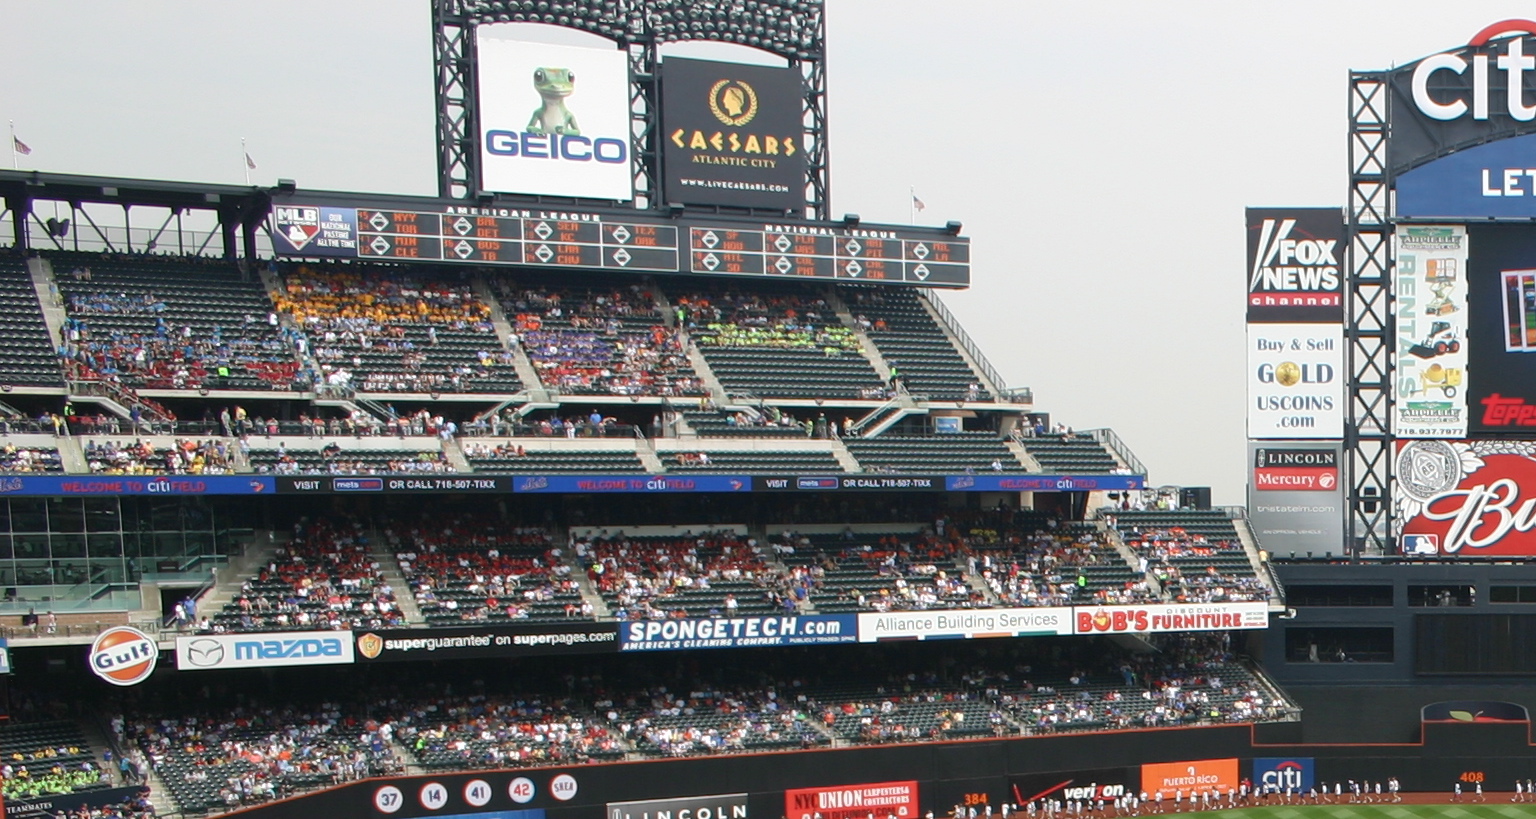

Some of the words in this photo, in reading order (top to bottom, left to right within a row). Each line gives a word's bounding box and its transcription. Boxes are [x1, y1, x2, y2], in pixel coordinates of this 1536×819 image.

[486, 130, 627, 165] GEICO
[671, 129, 797, 157] CAESARS
[692, 155, 748, 168] ATLANTIC
[750, 159, 777, 169] CITY
[277, 209, 317, 222] MLB
[447, 206, 530, 218] AMERICAN
[540, 212, 601, 222] LEAGUE
[765, 225, 835, 236] NATIONAL
[844, 229, 897, 240] LEAGUE
[395, 248, 418, 257] CLE
[1279, 240, 1338, 265] FOX
[1262, 267, 1339, 291] NEWS
[1251, 296, 1339, 306] channel
[1398, 255, 1416, 399] RENTALS
[1256, 339, 1285, 353] Buy
[1290, 340, 1302, 351] &
[1305, 338, 1334, 351] Sell
[1257, 362, 1334, 387] GOLD
[1256, 395, 1334, 411] USCOINS
[1276, 413, 1314, 429] .com
[1269, 453, 1334, 465] LINCOLN
[62, 482, 124, 492] WELCOME
[127, 481, 143, 492] TO
[147, 480, 171, 493] citi
[172, 481, 206, 492] FIELD
[294, 480, 320, 490] VISIT
[389, 479, 406, 489] OR
[407, 479, 434, 489] CALL
[436, 479, 496, 489] 718-507-TIXX
[766, 479, 788, 488] VISIT
[843, 479, 857, 488] OR
[858, 479, 881, 488] CALL
[882, 479, 932, 488] 718-507-TIXX
[1258, 473, 1316, 488] Mercury
[876, 615, 933, 632] Alliance
[937, 614, 995, 632] Building
[1000, 612, 1059, 628] Services
[1077, 609, 1148, 634] BOB'S
[1152, 612, 1243, 631] FURNITURE
[629, 617, 841, 643] SPONGETECH.com
[384, 634, 490, 650] superguarantee
[496, 636, 511, 646] on
[513, 632, 614, 647] superpages.com
[622, 638, 682, 651] AMERICA'S
[683, 637, 734, 649] CLEANING
[736, 636, 783, 647] COMPANY.
[96, 641, 151, 669] Gulf
[235, 638, 343, 661] mazda
[1163, 776, 1196, 787] PUERTO
[1262, 766, 1302, 789] citi
[1460, 771, 1484, 783] 408
[471, 786, 485, 799] 41
[514, 783, 530, 797] 42
[555, 782, 574, 793] SHEA
[1063, 783, 1124, 801] verizon
[382, 792, 397, 807] 37
[428, 790, 441, 802] 14
[794, 793, 820, 810] NYC
[818, 790, 864, 810] UNION
[864, 795, 910, 807] CONTRACTORS
[964, 793, 988, 806] 384
[6, 801, 53, 814] TEAMMATES
[625, 804, 747, 819] LINCOLN
